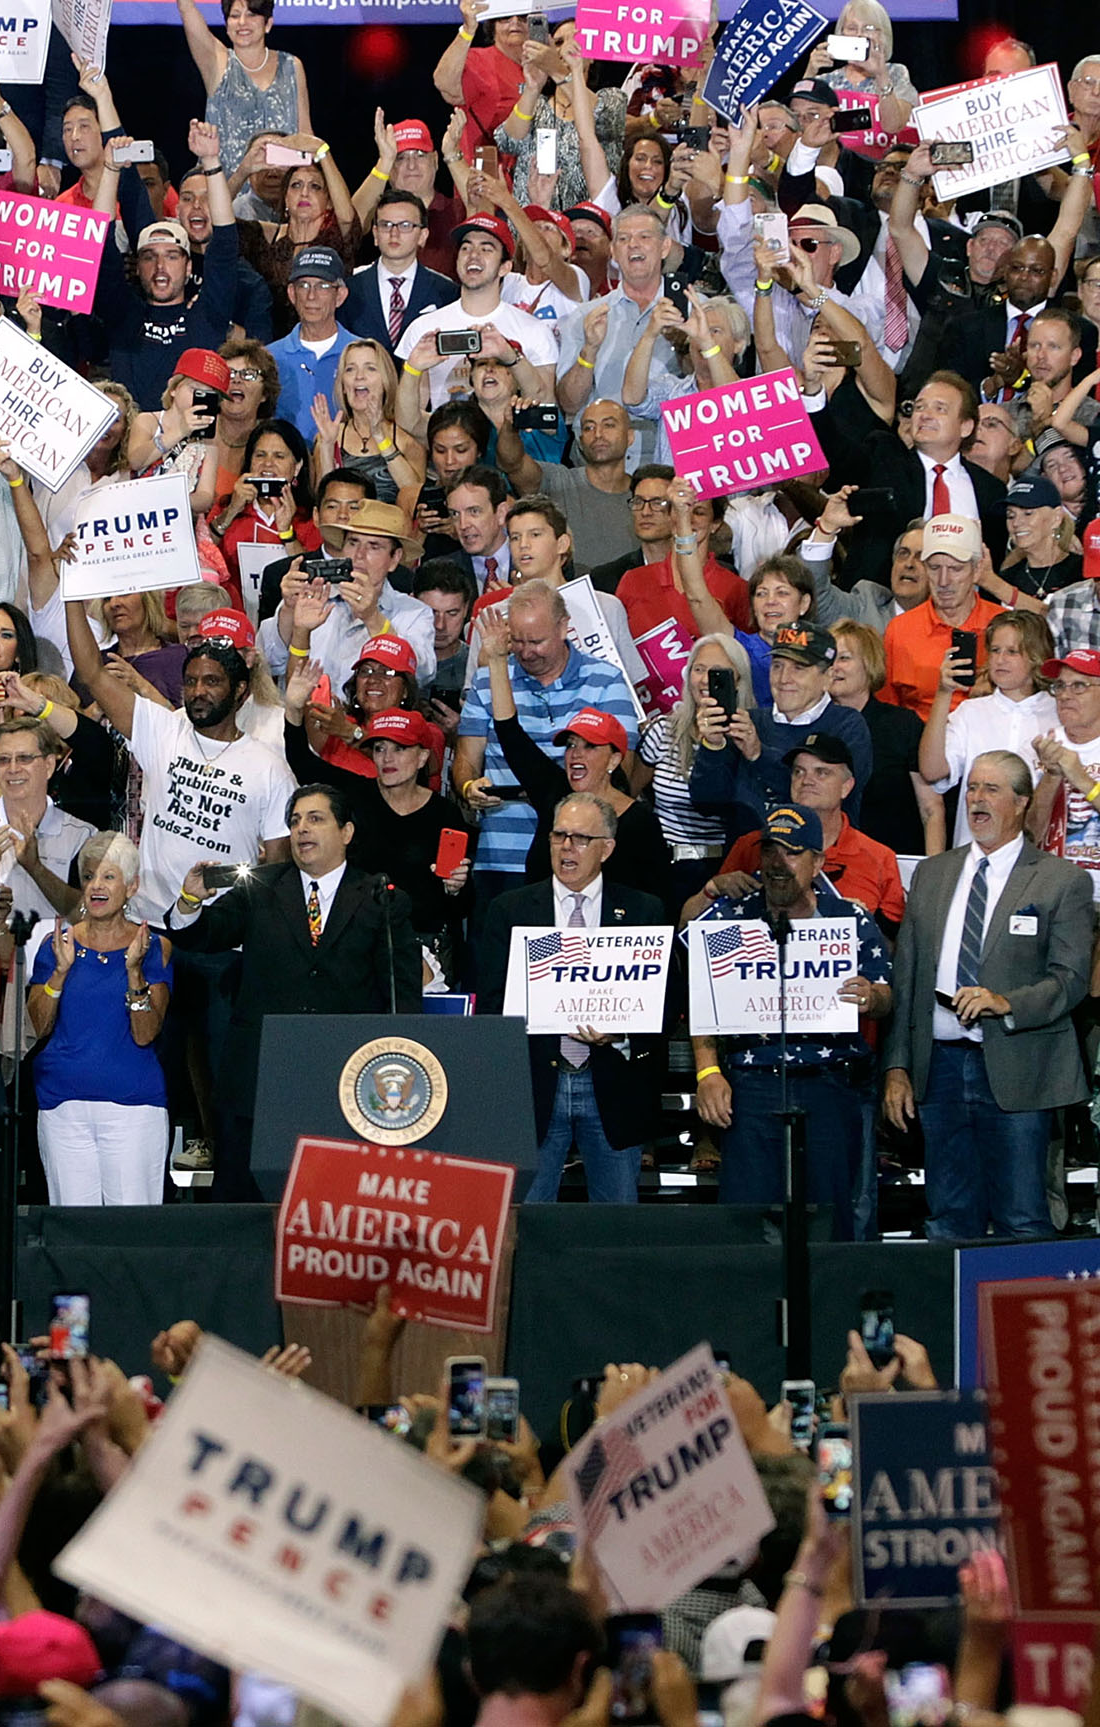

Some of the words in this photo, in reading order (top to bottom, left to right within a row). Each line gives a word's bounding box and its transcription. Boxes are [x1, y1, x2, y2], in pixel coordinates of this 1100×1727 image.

[617, 6, 664, 25] FOR
[581, 29, 700, 59] TRUMP
[722, 18, 752, 61] MAKE
[717, 0, 799, 112] AMERICA
[728, 51, 772, 116] STRONG
[770, 8, 813, 56] AGAIN
[965, 90, 1003, 116] BUY
[934, 96, 1052, 141] AMERICAN
[973, 128, 1019, 154] HIRE
[15, 239, 56, 261] FOR
[28, 357, 68, 390] BUY
[2, 391, 44, 429] HIRE
[664, 377, 799, 433] WOMEN
[712, 425, 764, 452] FOR
[684, 442, 812, 494] TRUMP
[77, 507, 179, 540] TRUMP
[931, 523, 964, 535] TRUMP
[85, 531, 172, 555] PENCE
[101, 554, 130, 563] AMERICA
[132, 551, 153, 559] GREAT
[584, 633, 606, 660] BU
[777, 628, 808, 647] USA
[230, 772, 243, 787] &
[167, 782, 193, 805] Are
[199, 795, 232, 819] Not
[167, 802, 221, 832] Racist
[585, 935, 665, 949] VETERANS
[632, 949, 662, 961] FOR
[820, 943, 851, 956] FOR
[550, 964, 662, 983] TRUMP
[734, 960, 851, 979] TRUMP
[554, 997, 645, 1014] AMERICA
[589, 987, 615, 996] MAKE
[567, 1014, 596, 1024] GREAT
[598, 1013, 631, 1023] AGAIN!
[792, 1013, 826, 1022] AGAIN!
[358, 1171, 431, 1205] MAKE
[286, 1198, 492, 1264] AMERICA
[287, 1244, 390, 1281] PROUD
[397, 1258, 483, 1300] AGAIN
[1026, 1301, 1077, 1459] PROUD
[624, 1367, 712, 1439] VETERANS
[684, 1391, 720, 1427] FOR
[607, 1418, 733, 1520] TRUMP
[187, 1431, 435, 1586] TRUMP
[864, 1528, 999, 1569] STRON
[1042, 1466, 1093, 1603] AGAIN
[180, 1491, 391, 1621] PENCE
